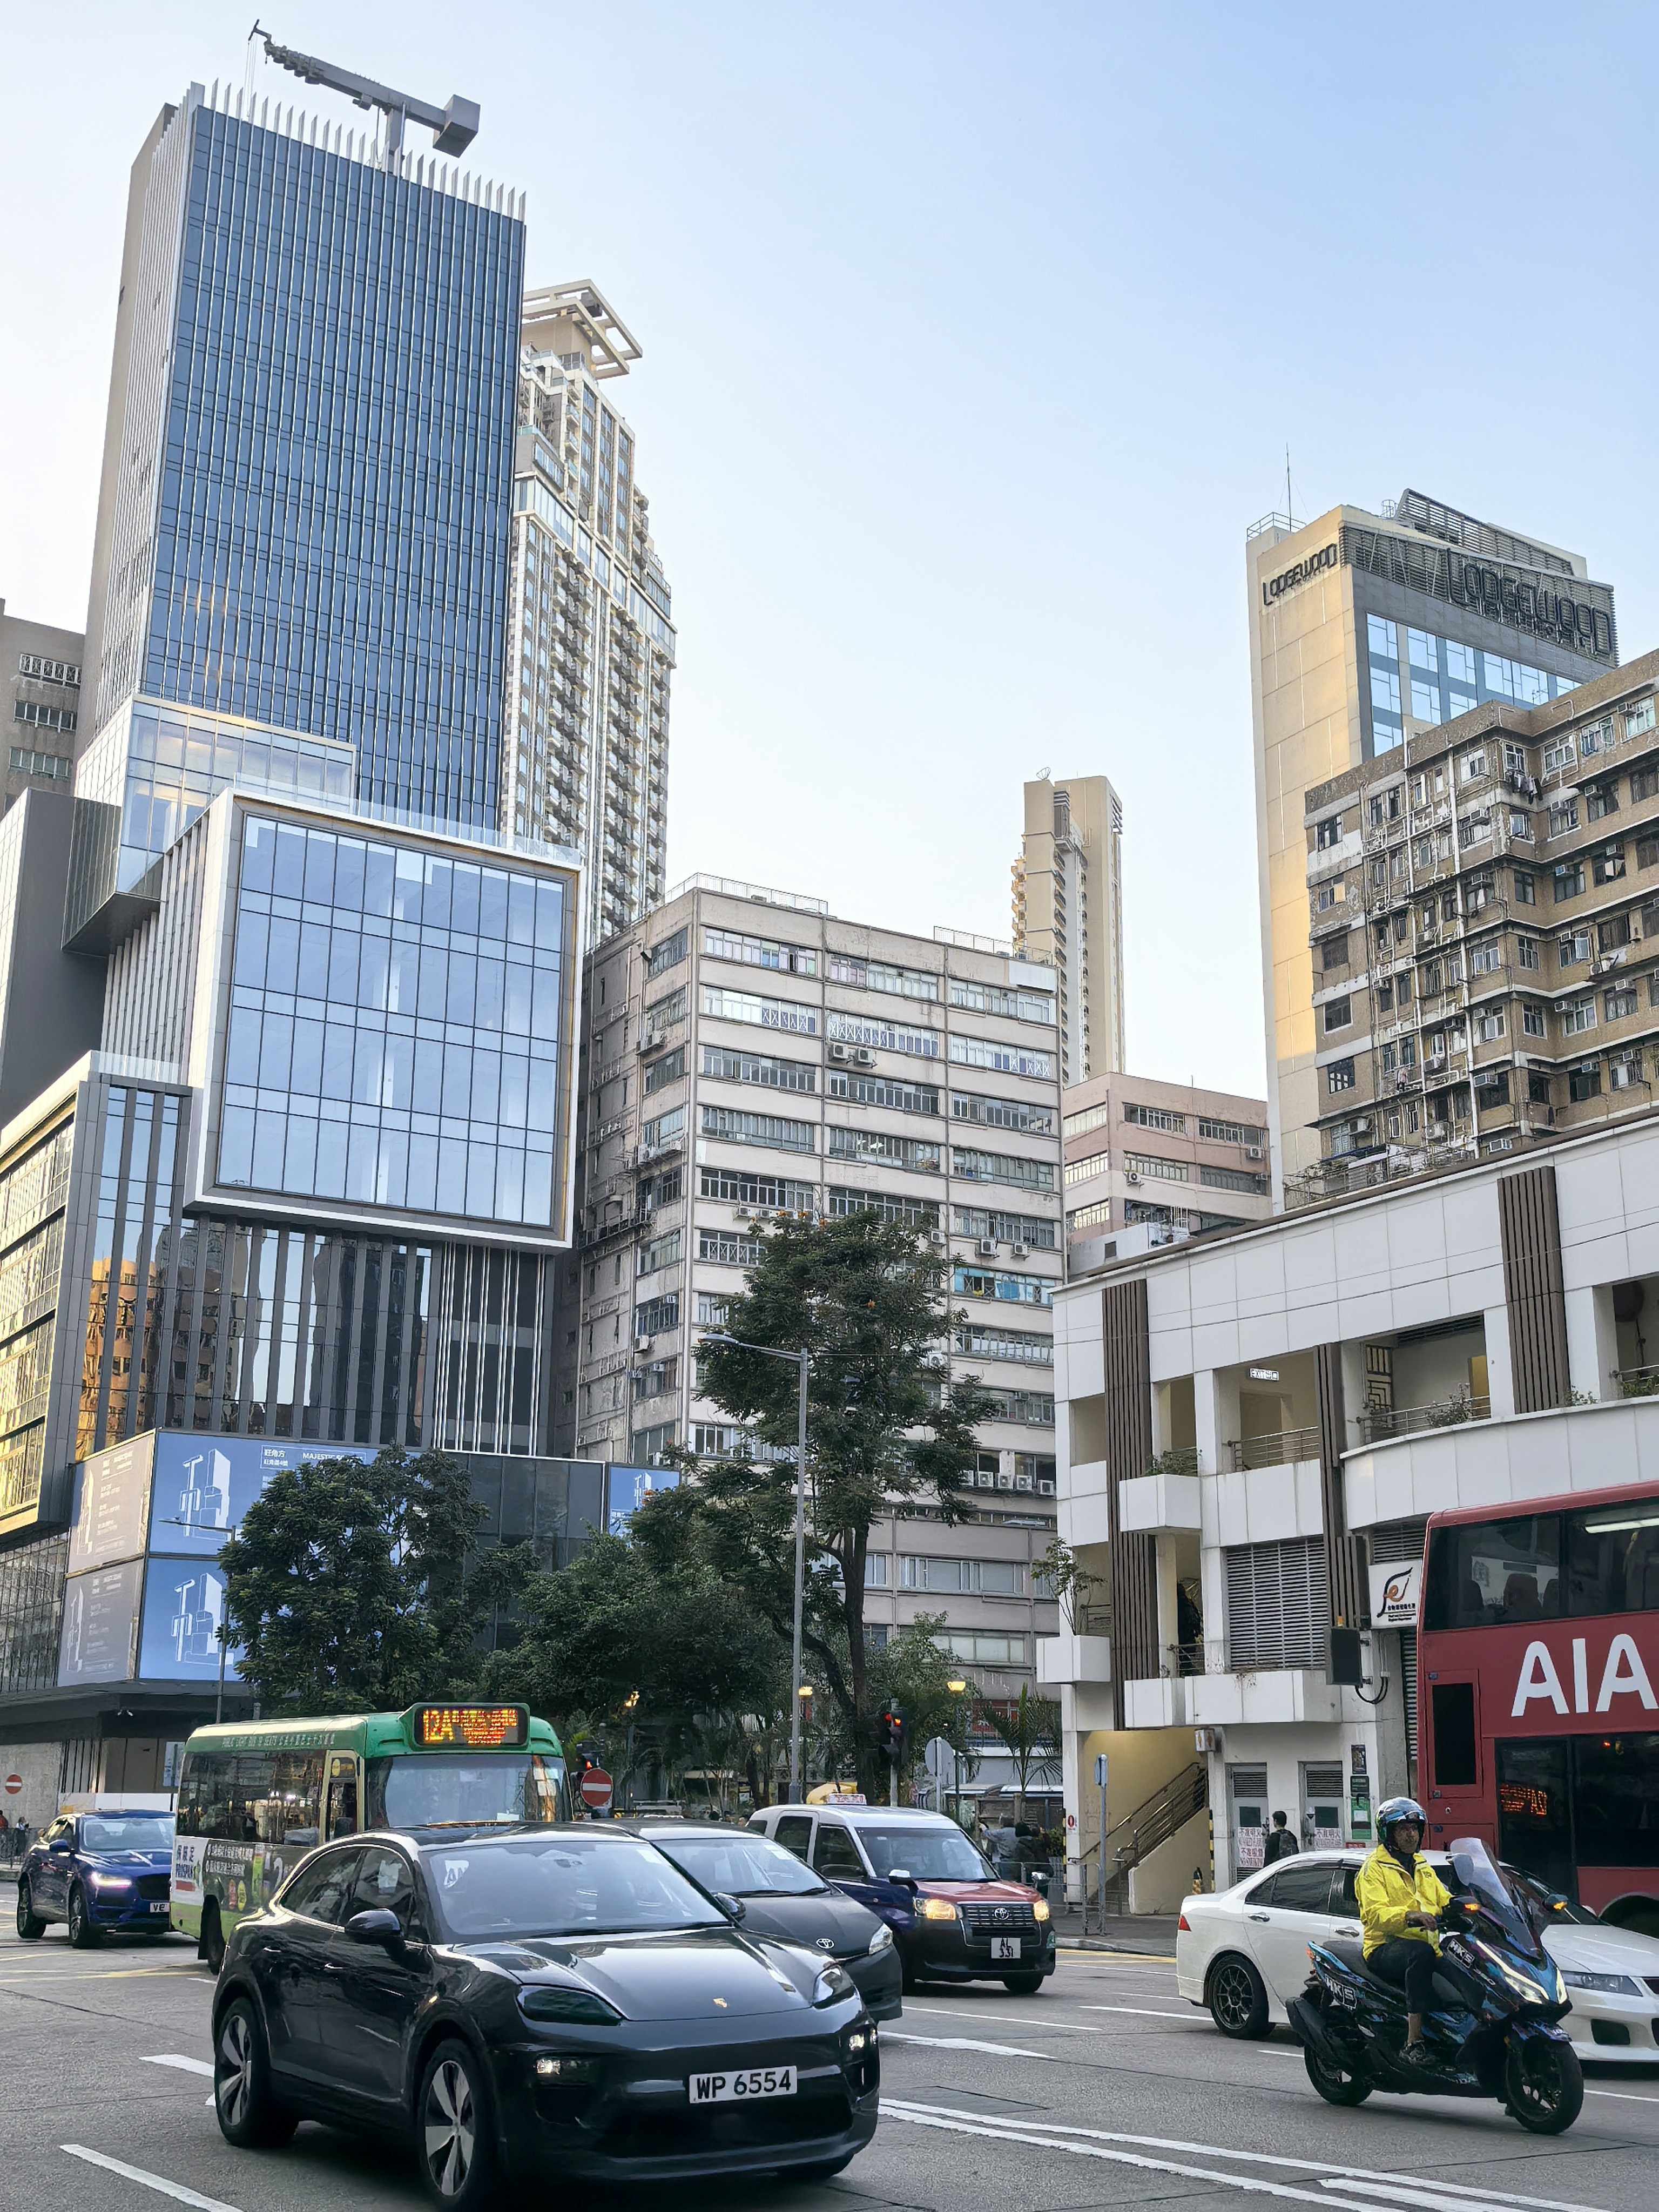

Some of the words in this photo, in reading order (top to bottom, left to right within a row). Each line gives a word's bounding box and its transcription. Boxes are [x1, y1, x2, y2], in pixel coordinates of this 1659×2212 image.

[1511, 1633, 1659, 1717] AIA
[1450, 1941, 1473, 1964] HKS
[1326, 1976, 1354, 2001] HKS
[697, 2076, 726, 2099] WP
[733, 2069, 791, 2095] 6554
